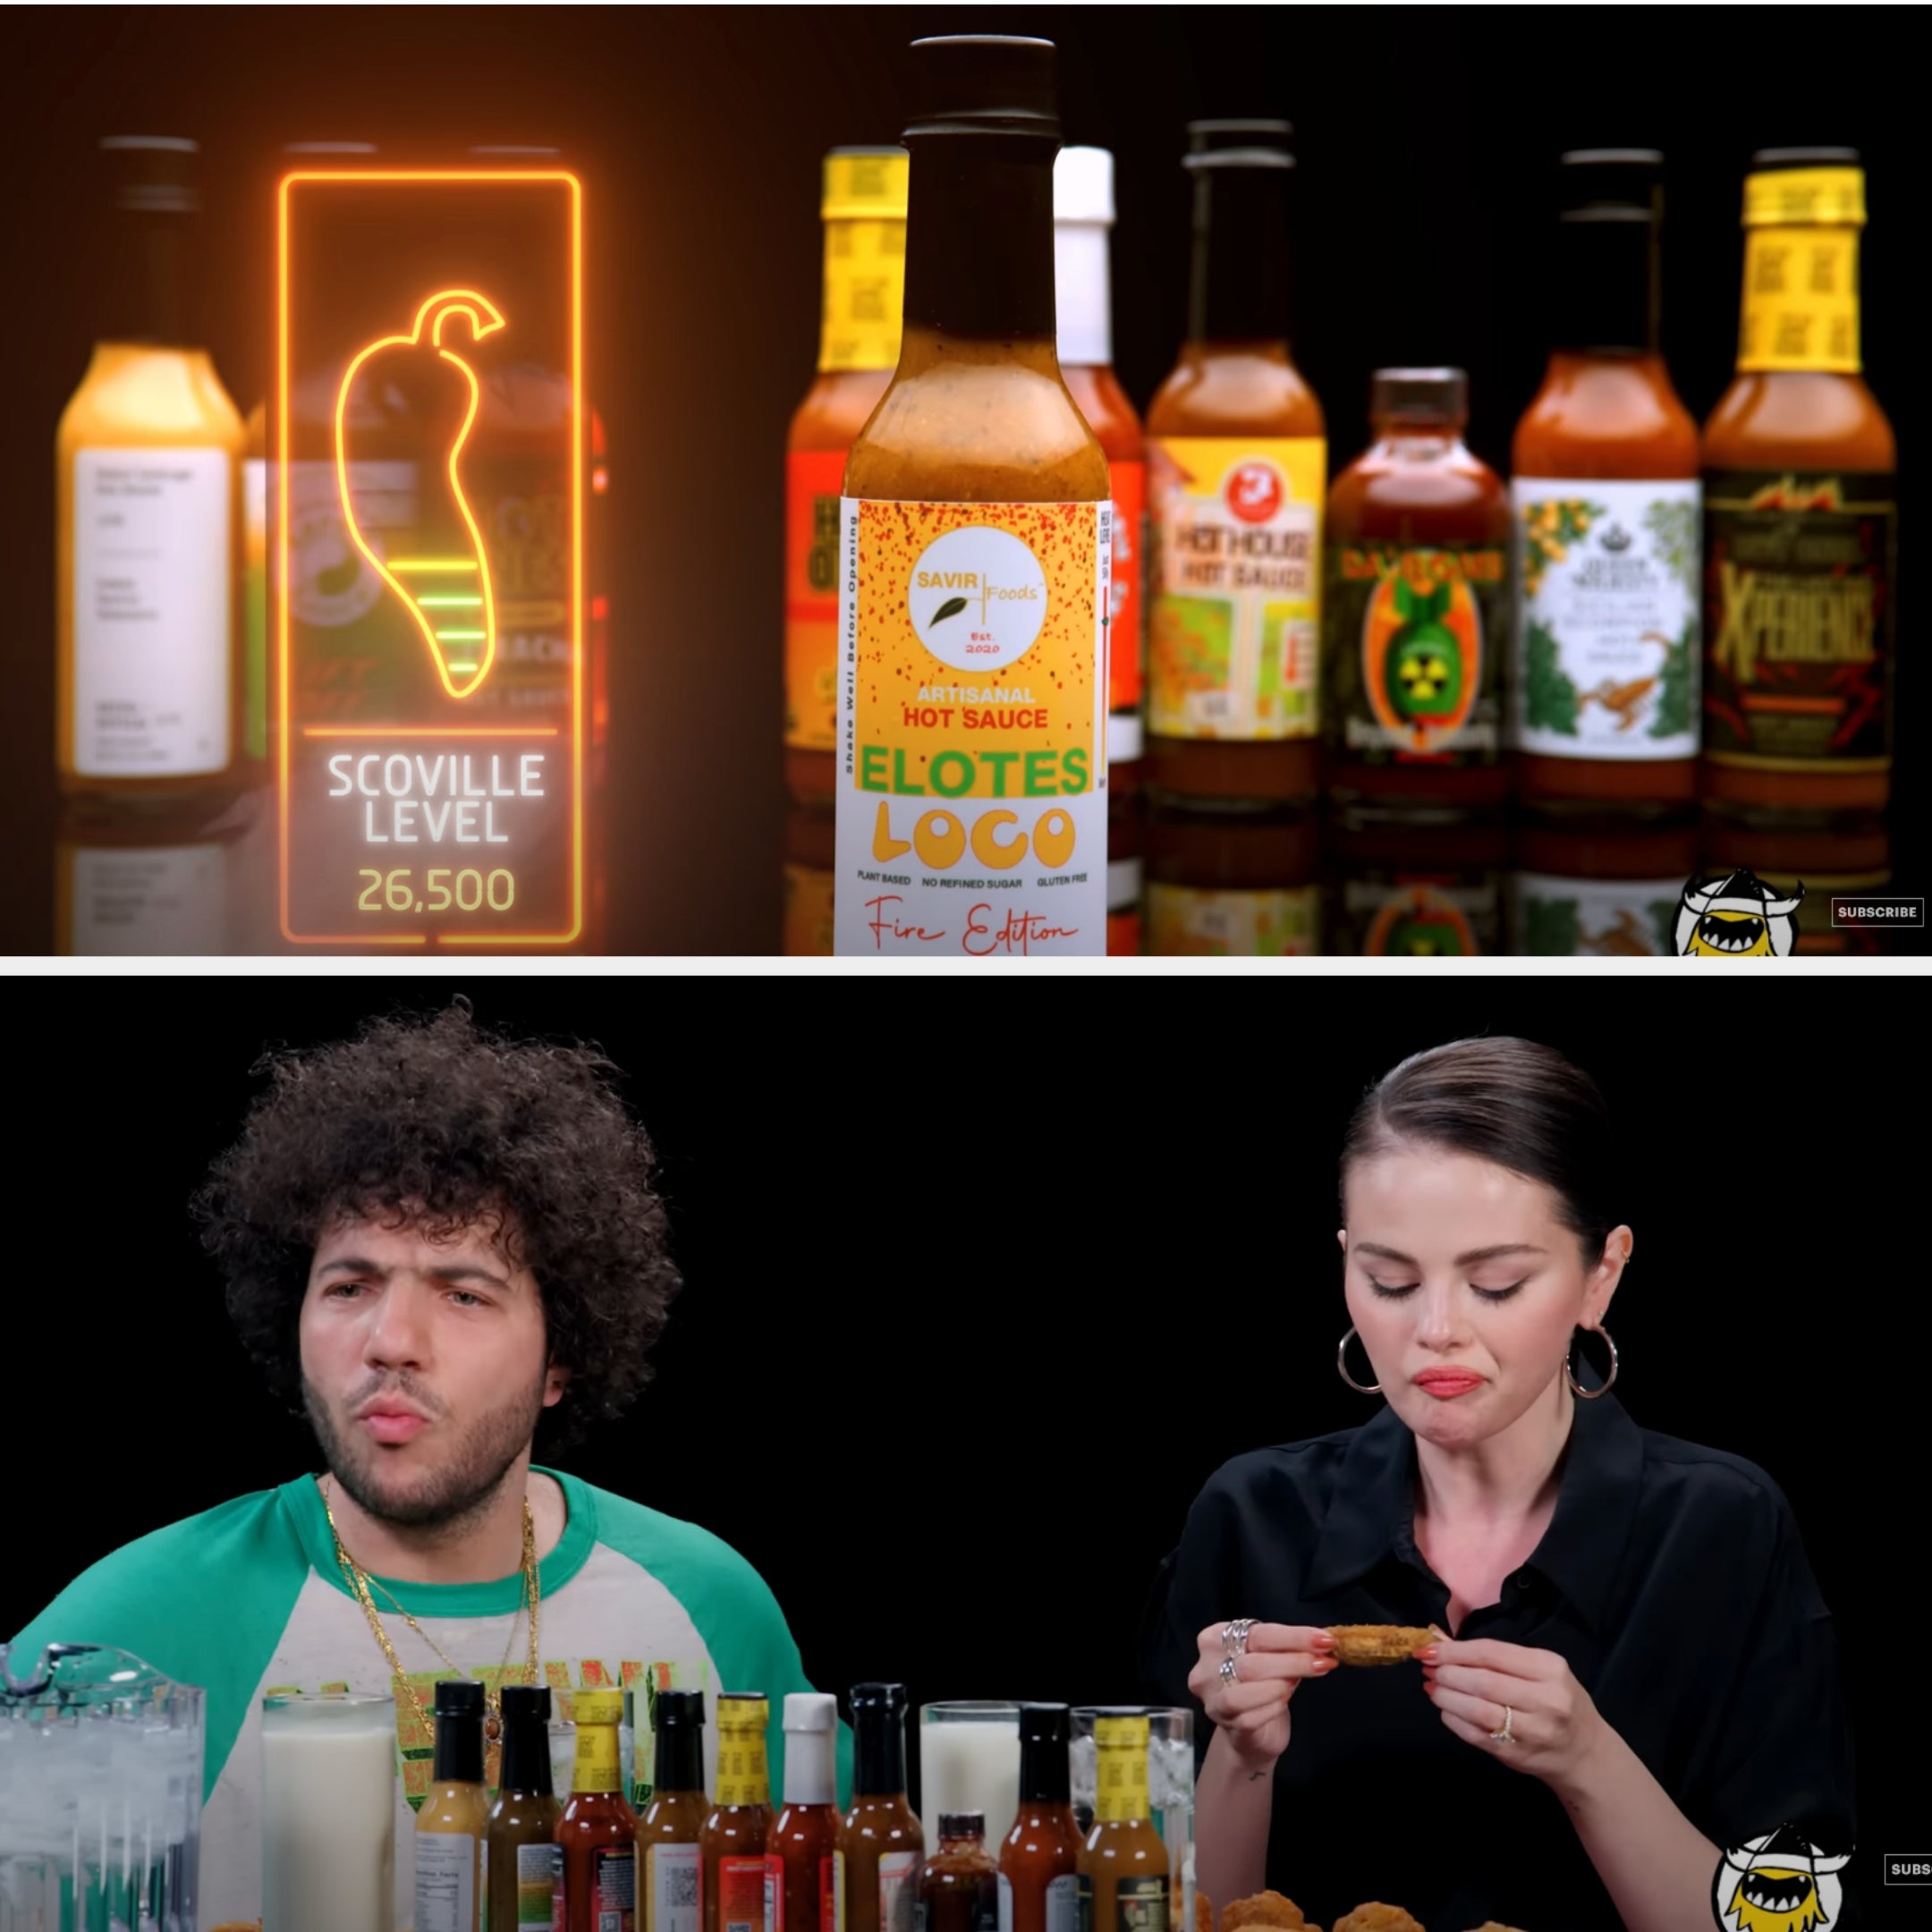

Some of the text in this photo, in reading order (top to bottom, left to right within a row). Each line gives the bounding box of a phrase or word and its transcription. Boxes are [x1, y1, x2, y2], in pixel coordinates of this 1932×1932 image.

[917, 572, 978, 589] SAVIR
[987, 583, 1038, 601] Foods
[845, 515, 858, 774] Shake Well Before Opening
[970, 631, 995, 642] Est.
[965, 644, 1000, 654] 2020
[917, 687, 1036, 704] ARTISANAL
[903, 708, 1048, 729] HOT SAUCE
[861, 745, 1088, 798] ELOTES
[872, 801, 1076, 870] LOCO
[857, 870, 911, 886] PLANT BASED
[922, 877, 1022, 888] NO REFINED SUGAR
[1037, 873, 1088, 887] GLUTEN FREE
[865, 895, 1079, 956] Fire Edition
